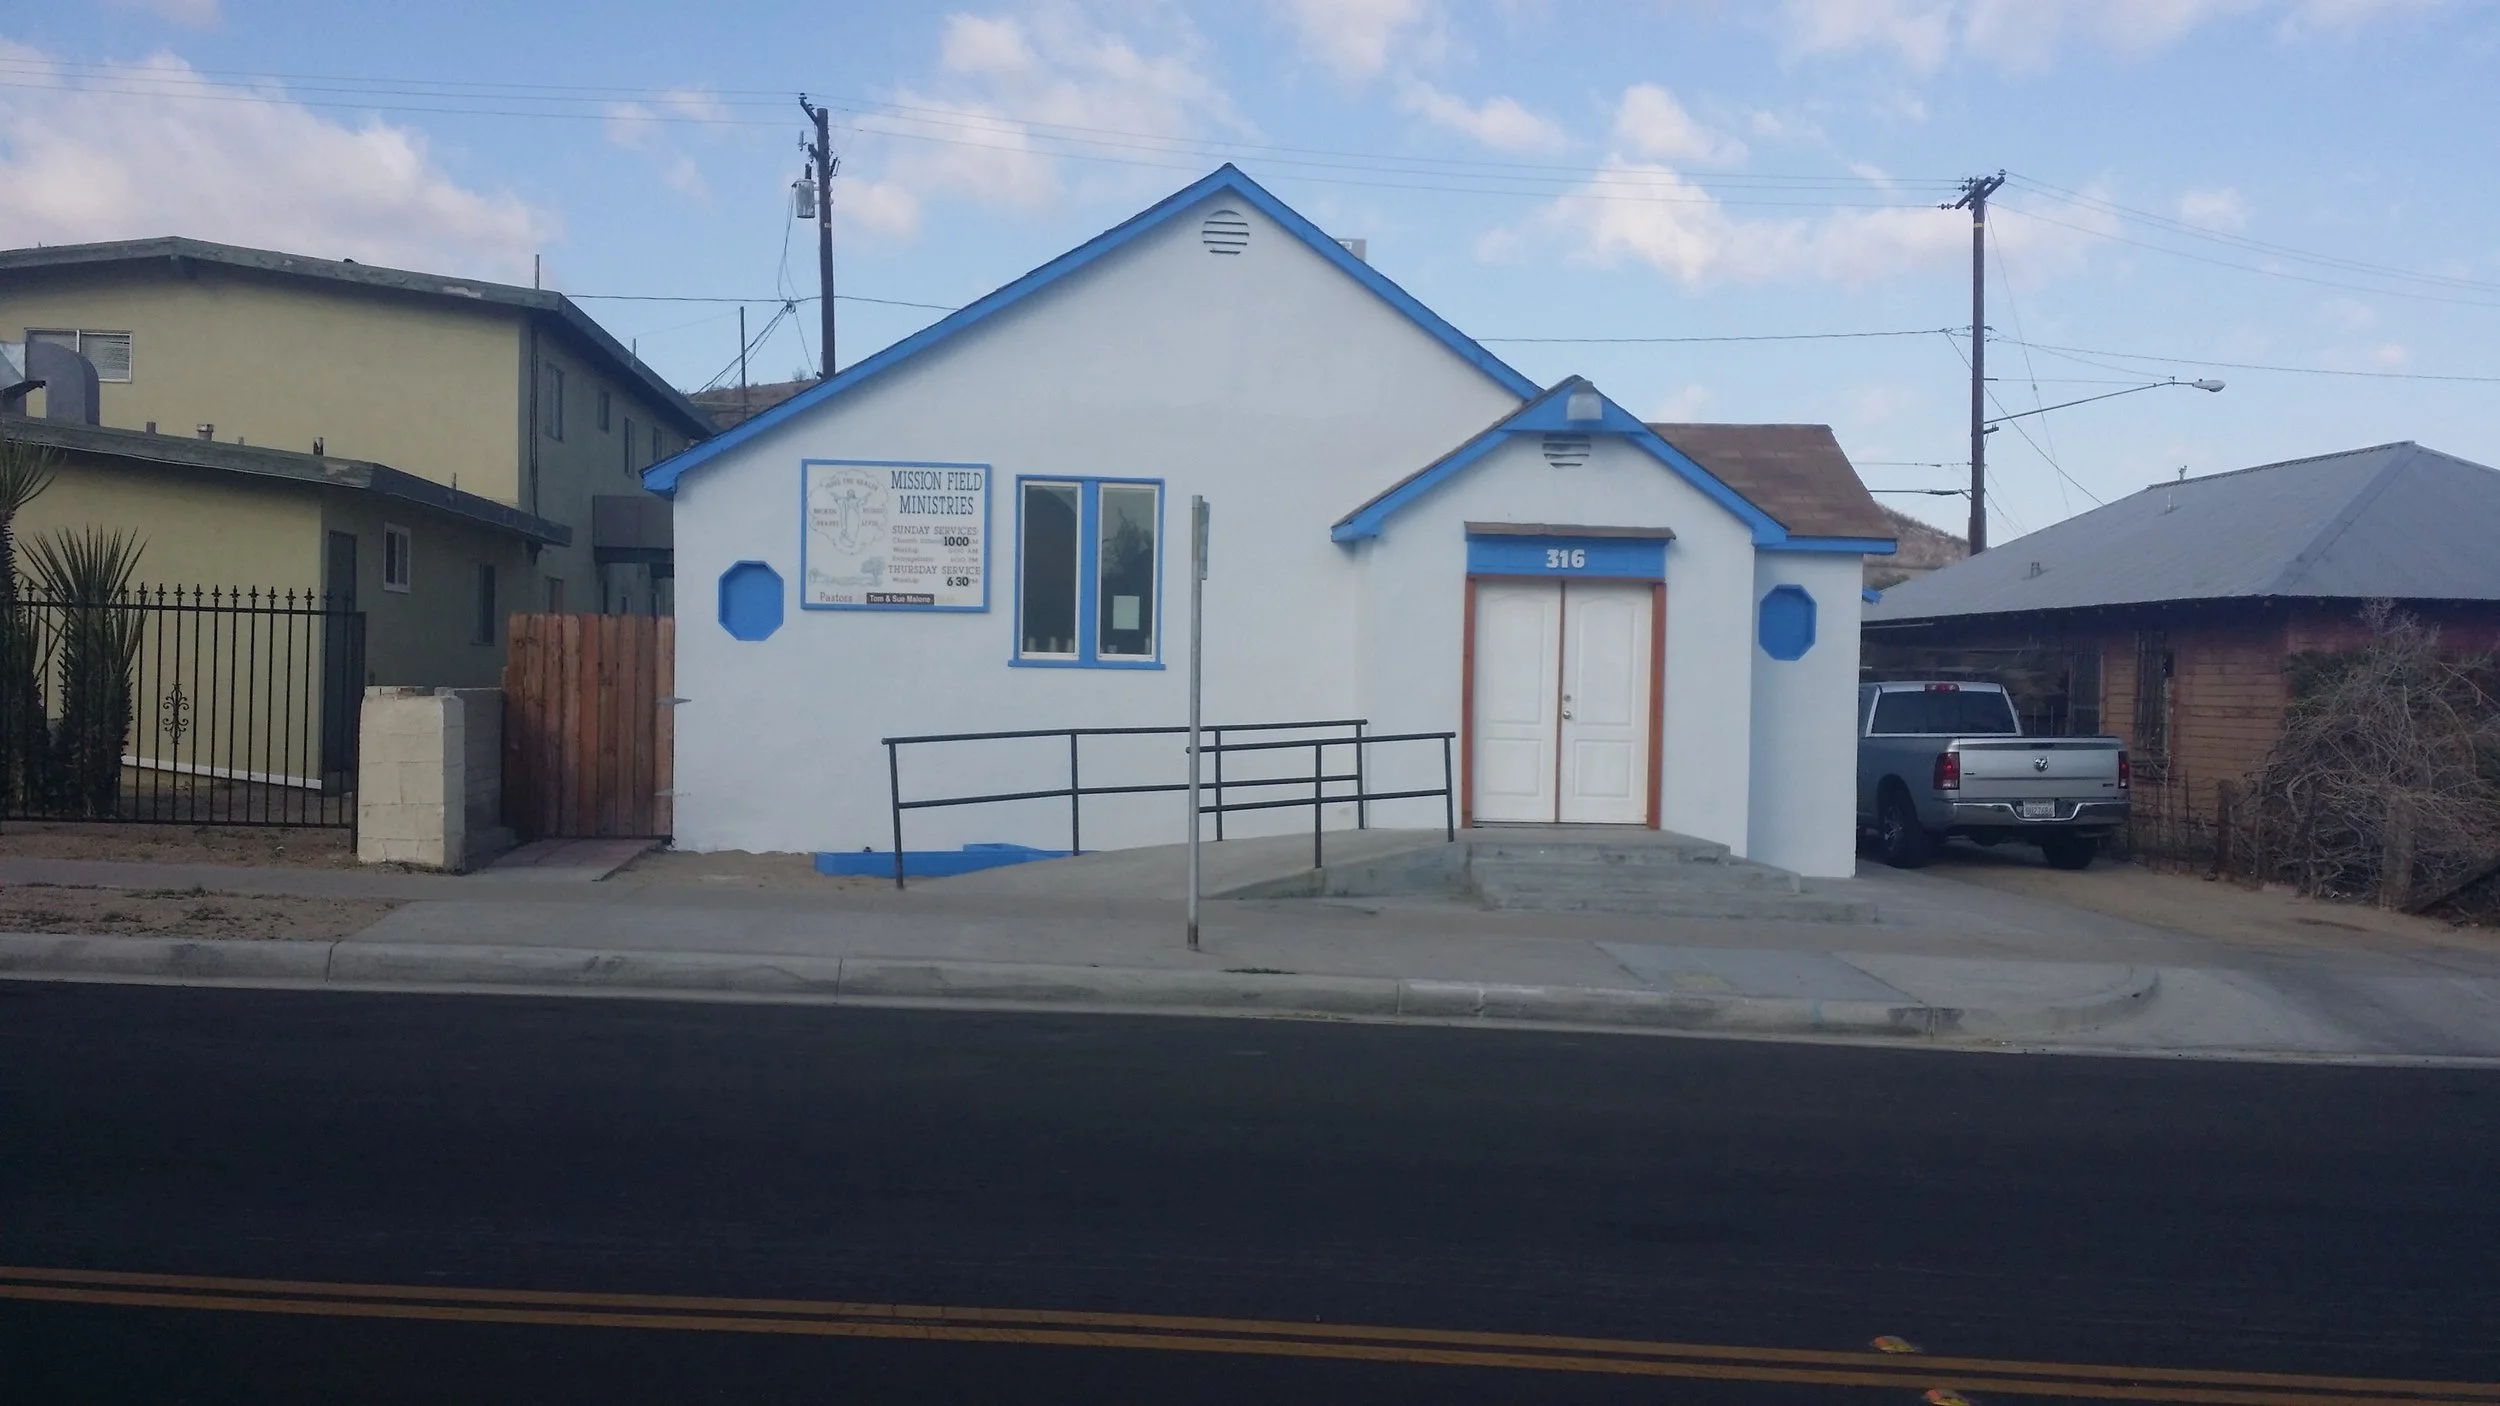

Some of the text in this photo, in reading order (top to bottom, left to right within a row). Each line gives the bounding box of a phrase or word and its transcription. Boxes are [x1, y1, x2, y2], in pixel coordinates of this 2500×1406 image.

[891, 470, 983, 491] MISSION FIELD
[900, 495, 974, 515] MINISTRIES
[892, 525, 978, 535] SUNDAY SERVICES
[1545, 549, 1585, 569] 316
[888, 564, 981, 575] THURSDAY SERVICE
[820, 591, 853, 602] Pastors
[870, 594, 884, 602] Tom
